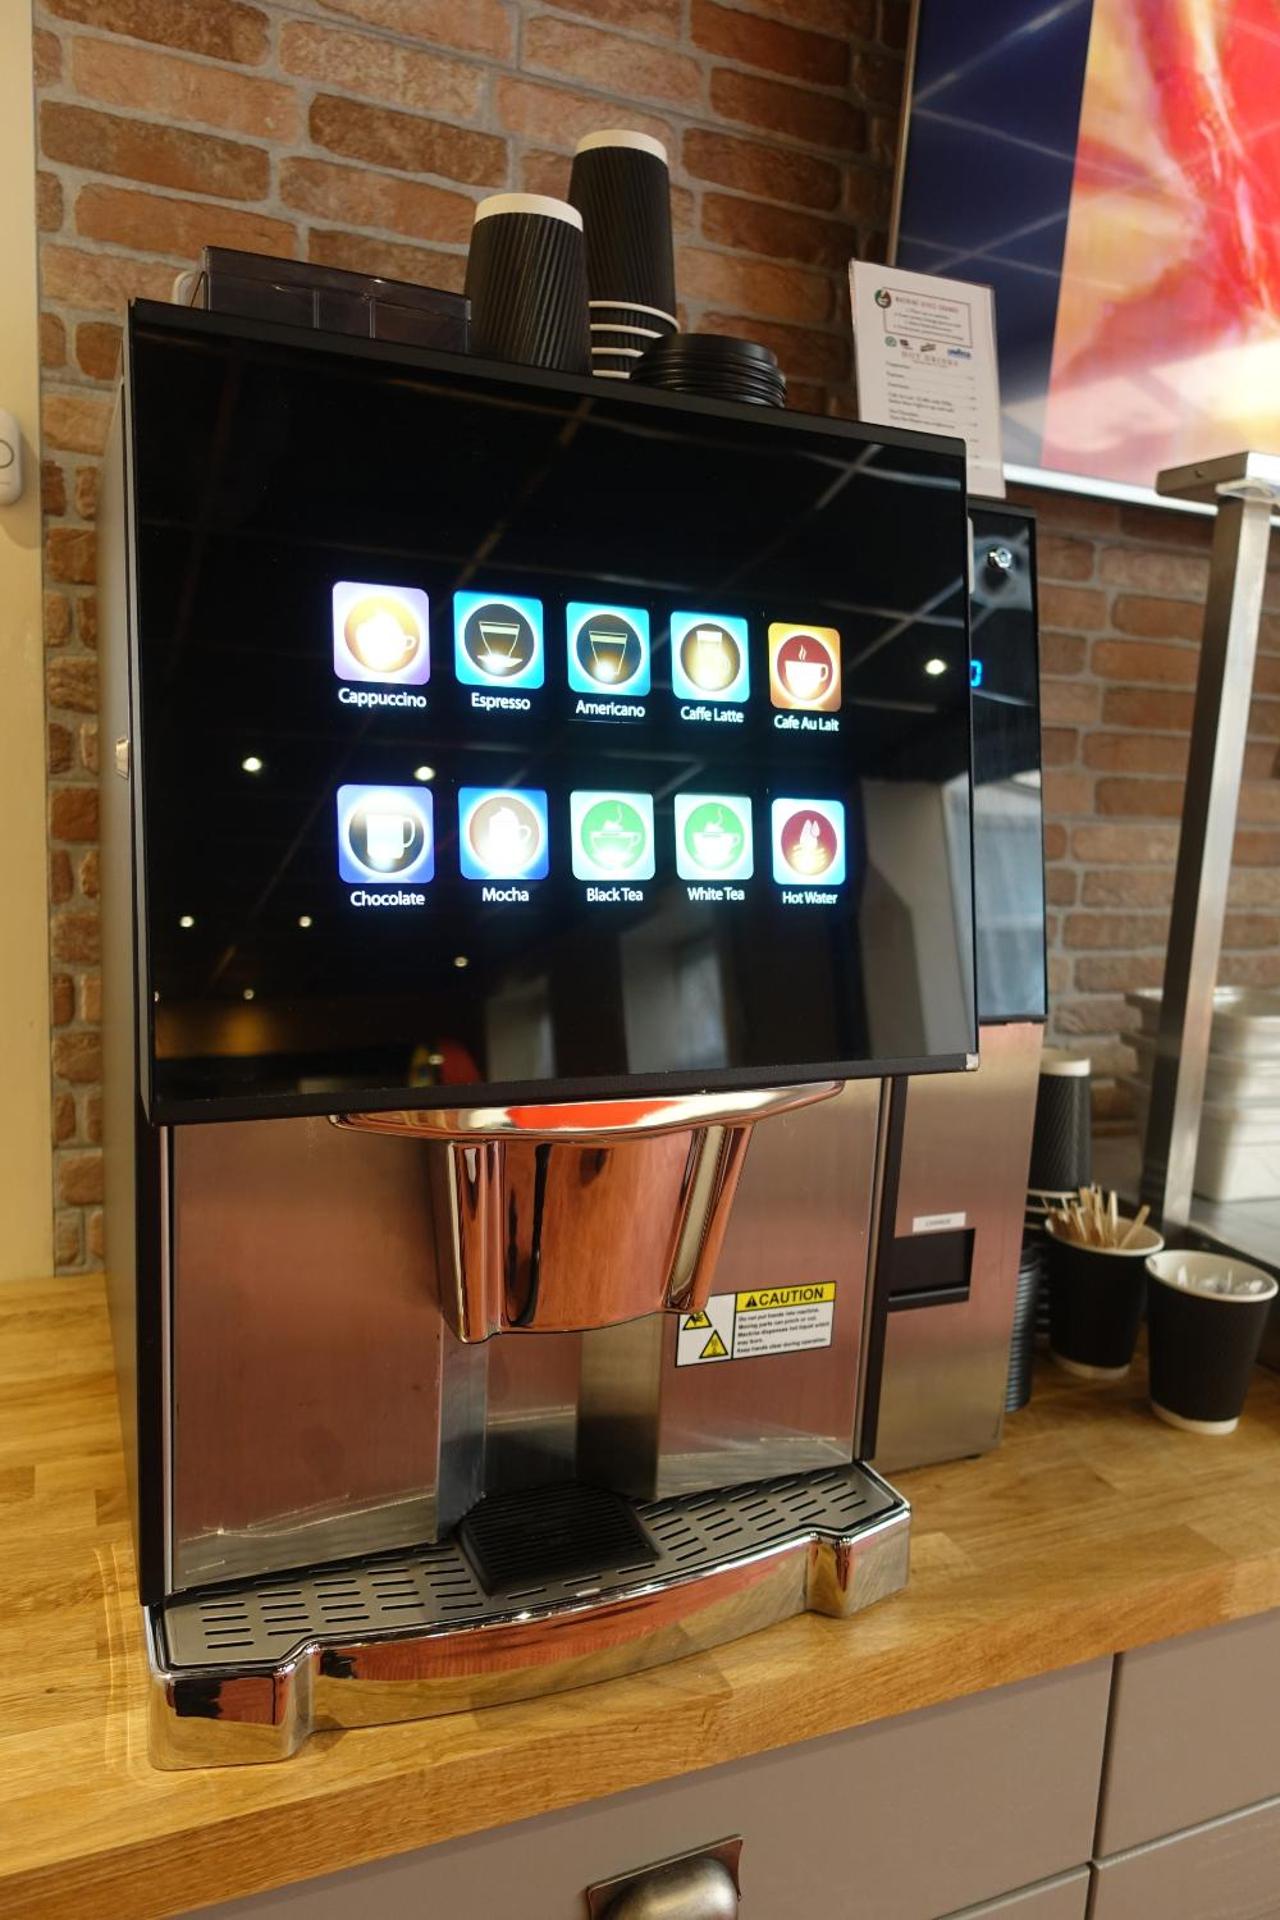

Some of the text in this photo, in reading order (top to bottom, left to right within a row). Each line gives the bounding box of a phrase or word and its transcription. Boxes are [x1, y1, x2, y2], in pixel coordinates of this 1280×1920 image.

[338, 687, 427, 708] Cappuccino
[471, 692, 531, 711] Espresso
[575, 699, 646, 718] Americano
[680, 705, 744, 723] Caffe Latte
[774, 714, 839, 732] Cafe Au Lait
[350, 890, 426, 906] Chocolate
[482, 887, 530, 902] Mocha
[586, 887, 643, 902] Black Tea
[687, 887, 745, 901] White Tea
[782, 891, 838, 905] Hot Water
[759, 1286, 824, 1306] CAUTION
